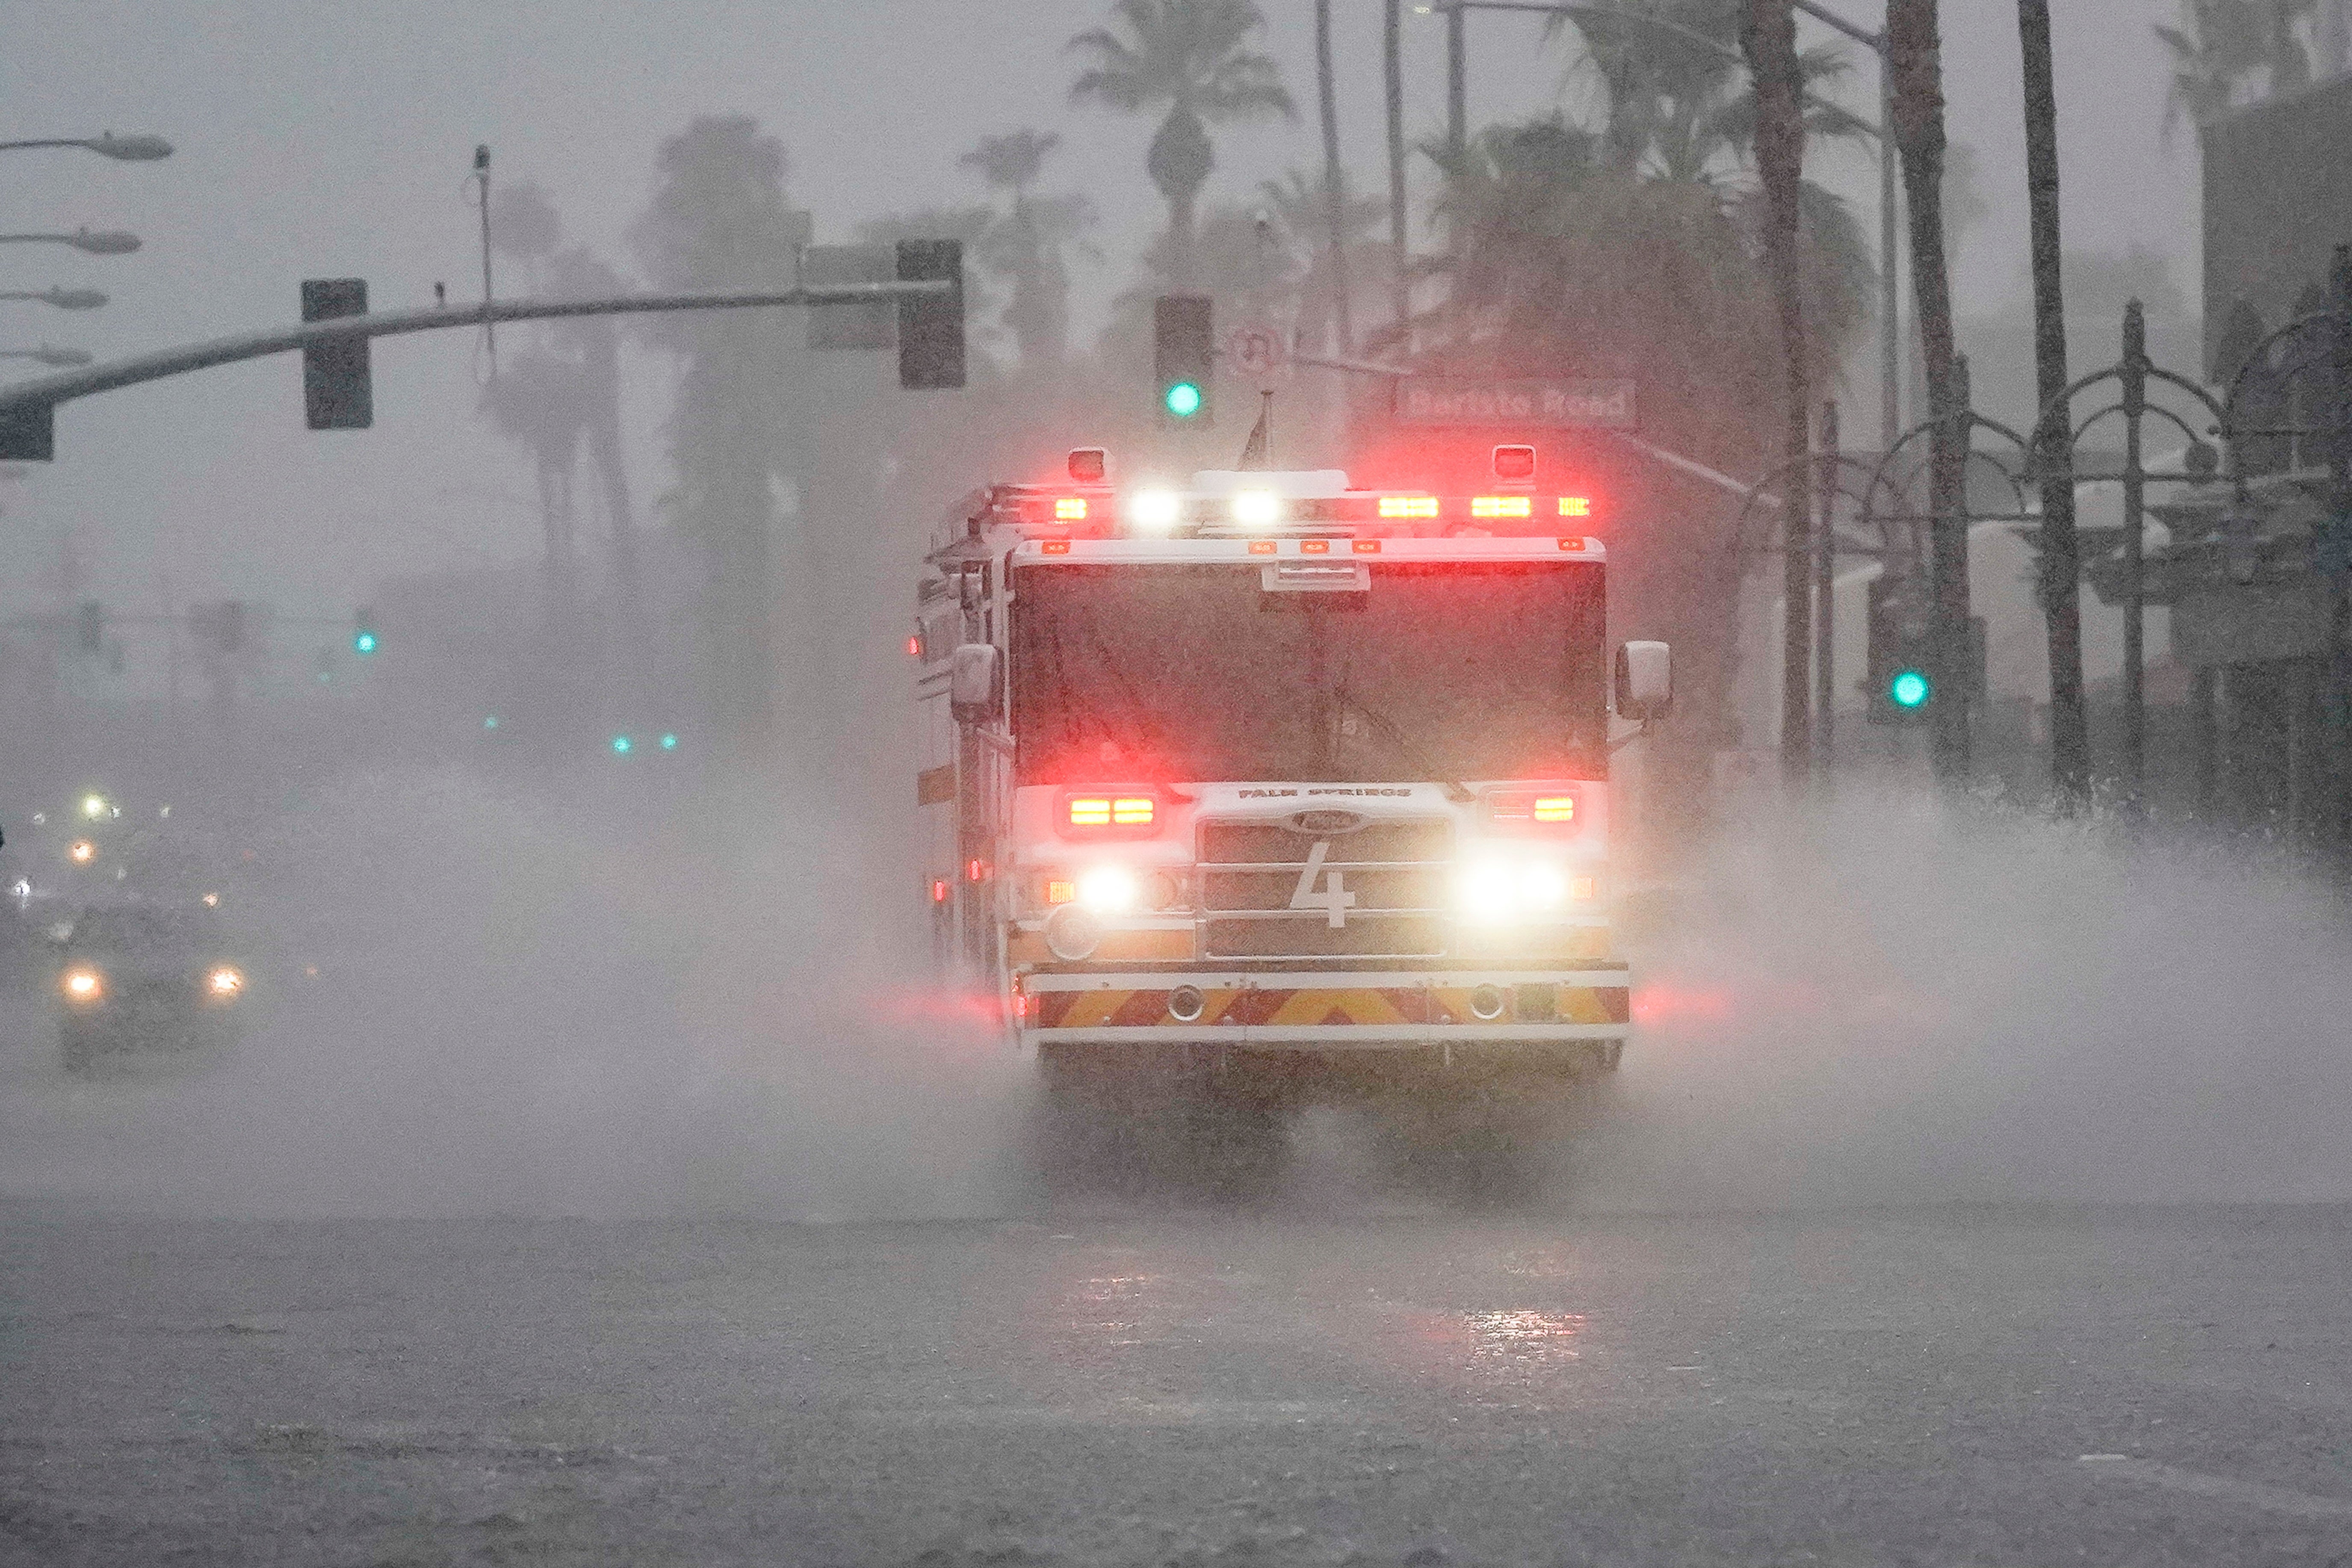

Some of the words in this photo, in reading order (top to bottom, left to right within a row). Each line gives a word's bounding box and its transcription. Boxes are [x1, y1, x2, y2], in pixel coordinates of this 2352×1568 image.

[1543, 389, 1626, 416] Road
[1238, 789, 1297, 798] PALM
[1308, 788, 1411, 797] SPRINGS
[1290, 842, 1356, 928] 4
